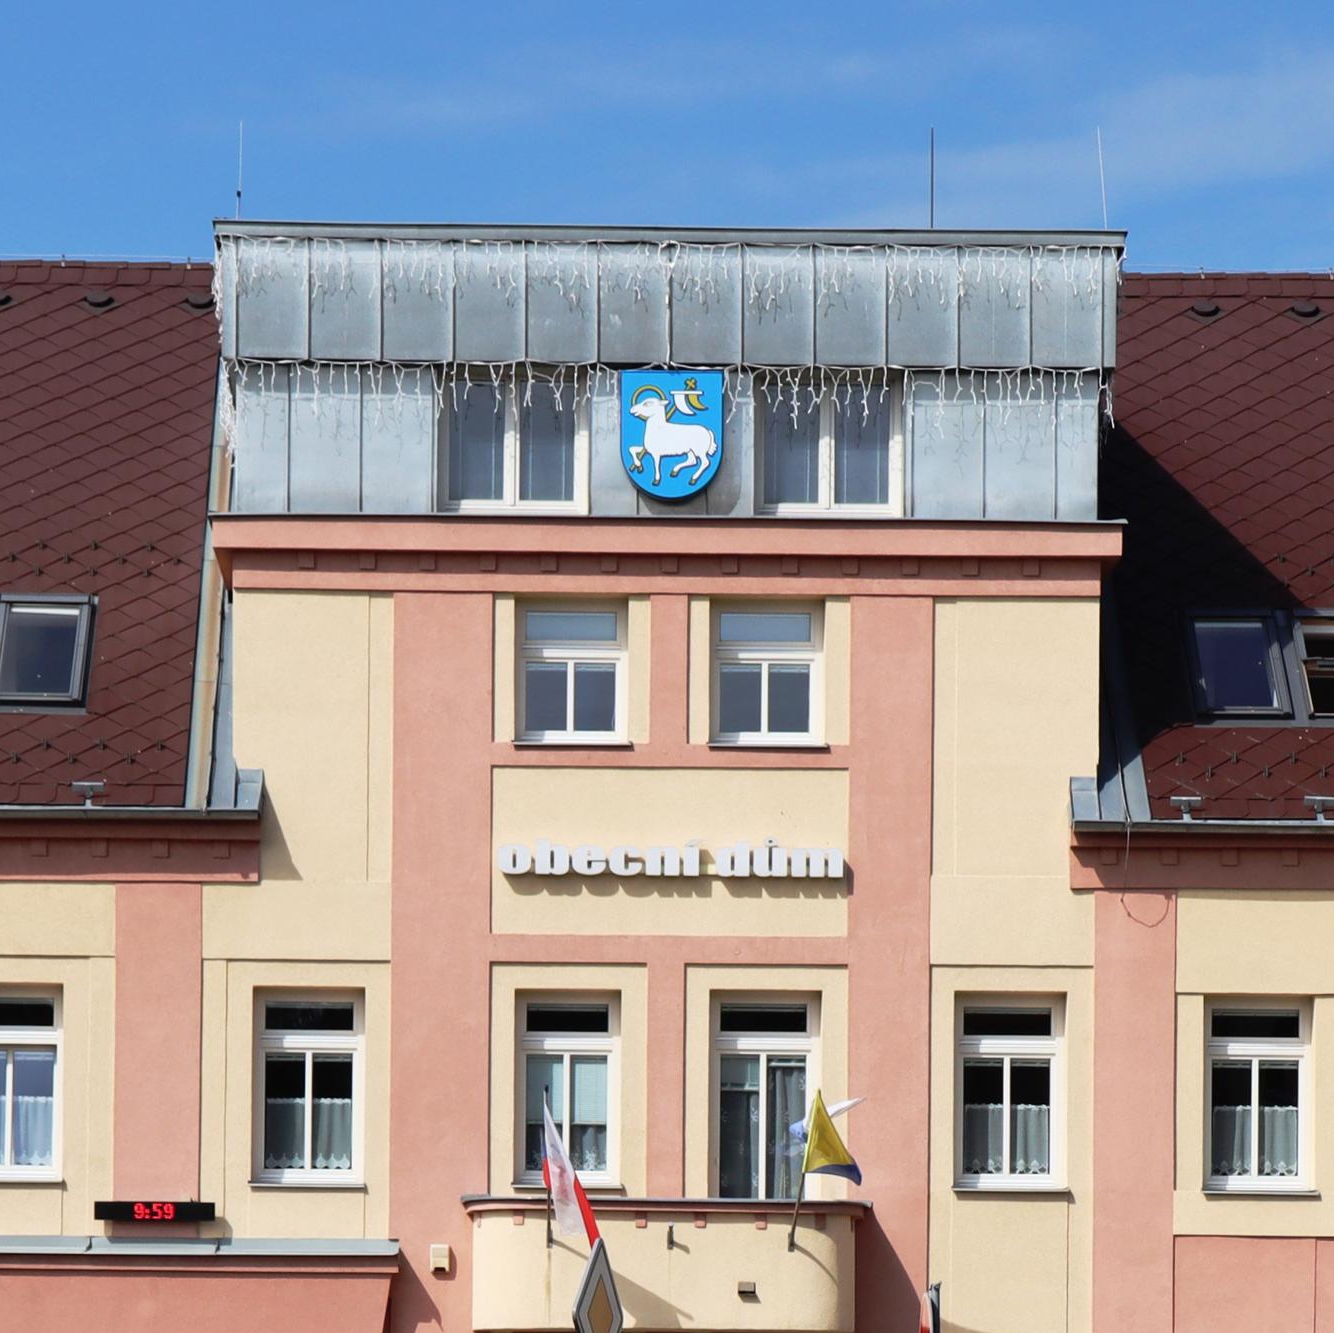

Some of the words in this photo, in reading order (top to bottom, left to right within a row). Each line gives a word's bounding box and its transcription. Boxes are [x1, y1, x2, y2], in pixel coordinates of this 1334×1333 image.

[498, 839, 702, 877] obecní
[717, 838, 844, 878] dům
[133, 1202, 175, 1219] 9:59
